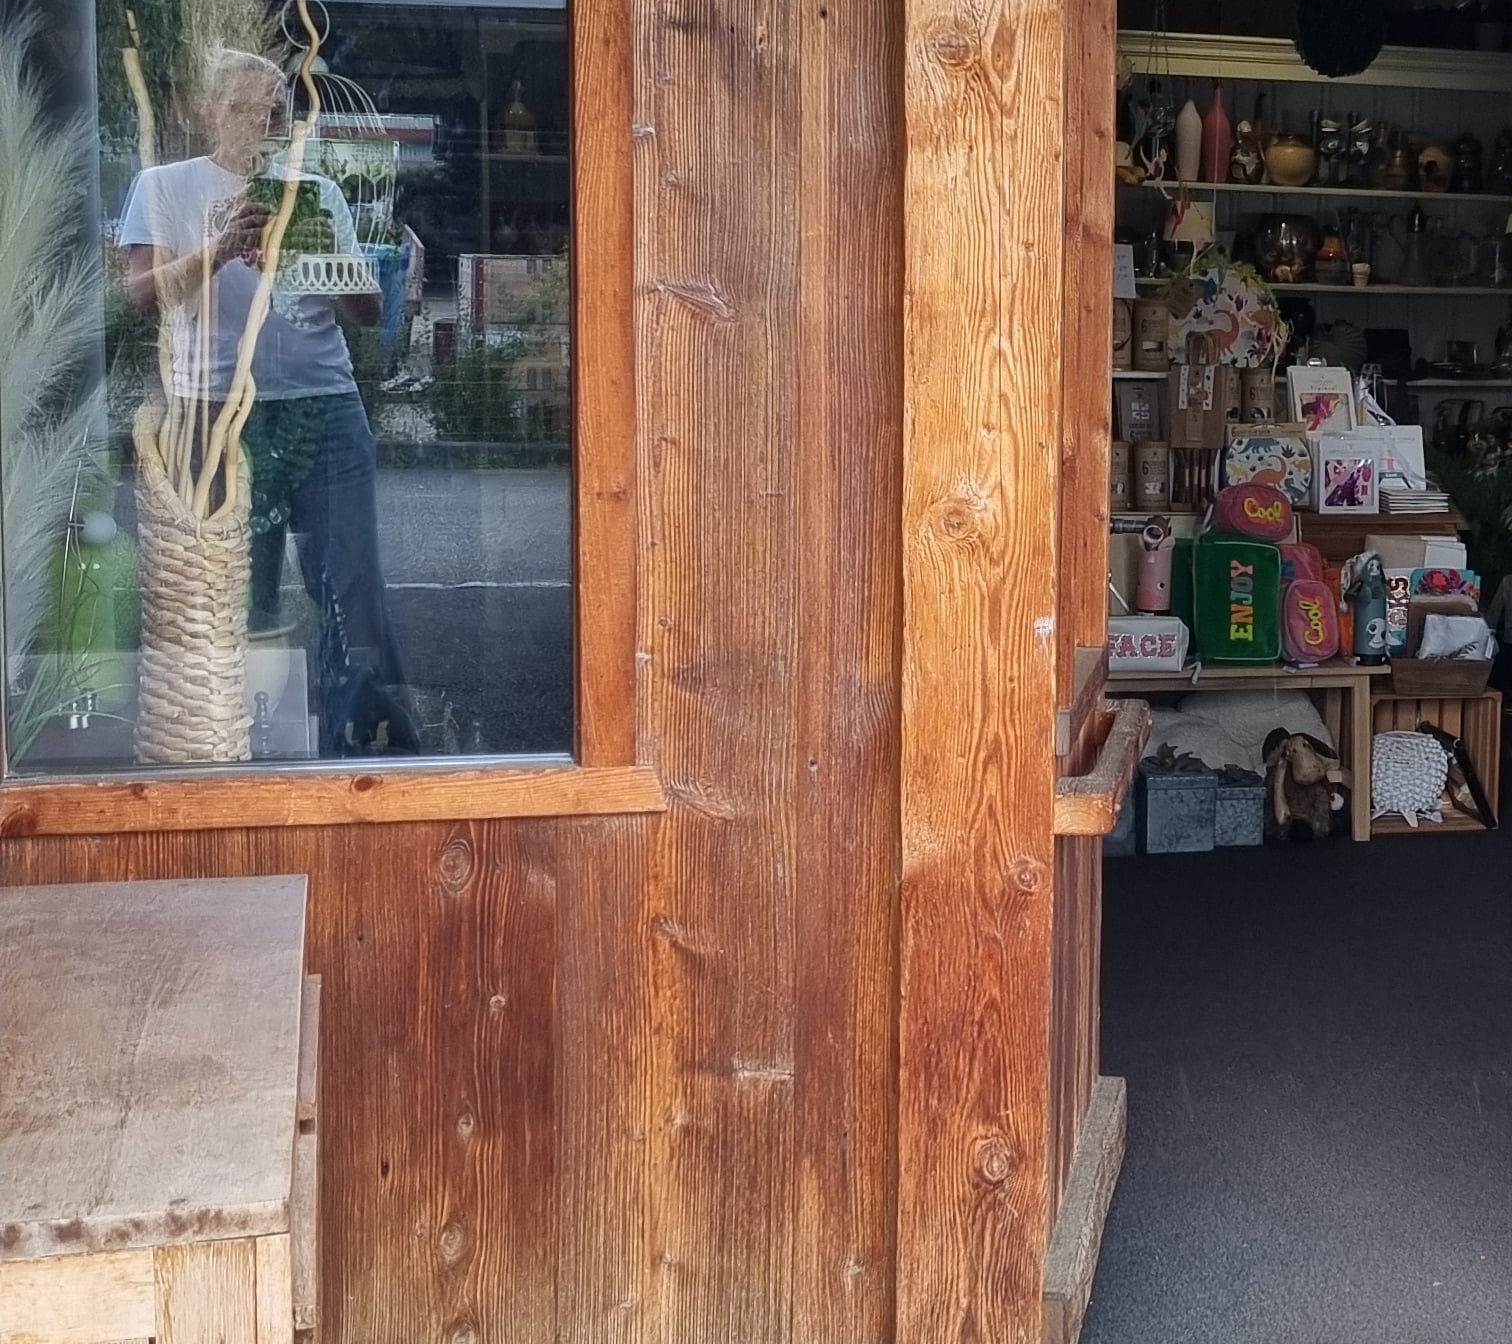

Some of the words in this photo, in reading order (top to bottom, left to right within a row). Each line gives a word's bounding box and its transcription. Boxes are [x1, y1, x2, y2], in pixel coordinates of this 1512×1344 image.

[1244, 497, 1283, 523] Cool
[1230, 559, 1254, 641] ENJOY
[1299, 596, 1324, 646] Cool
